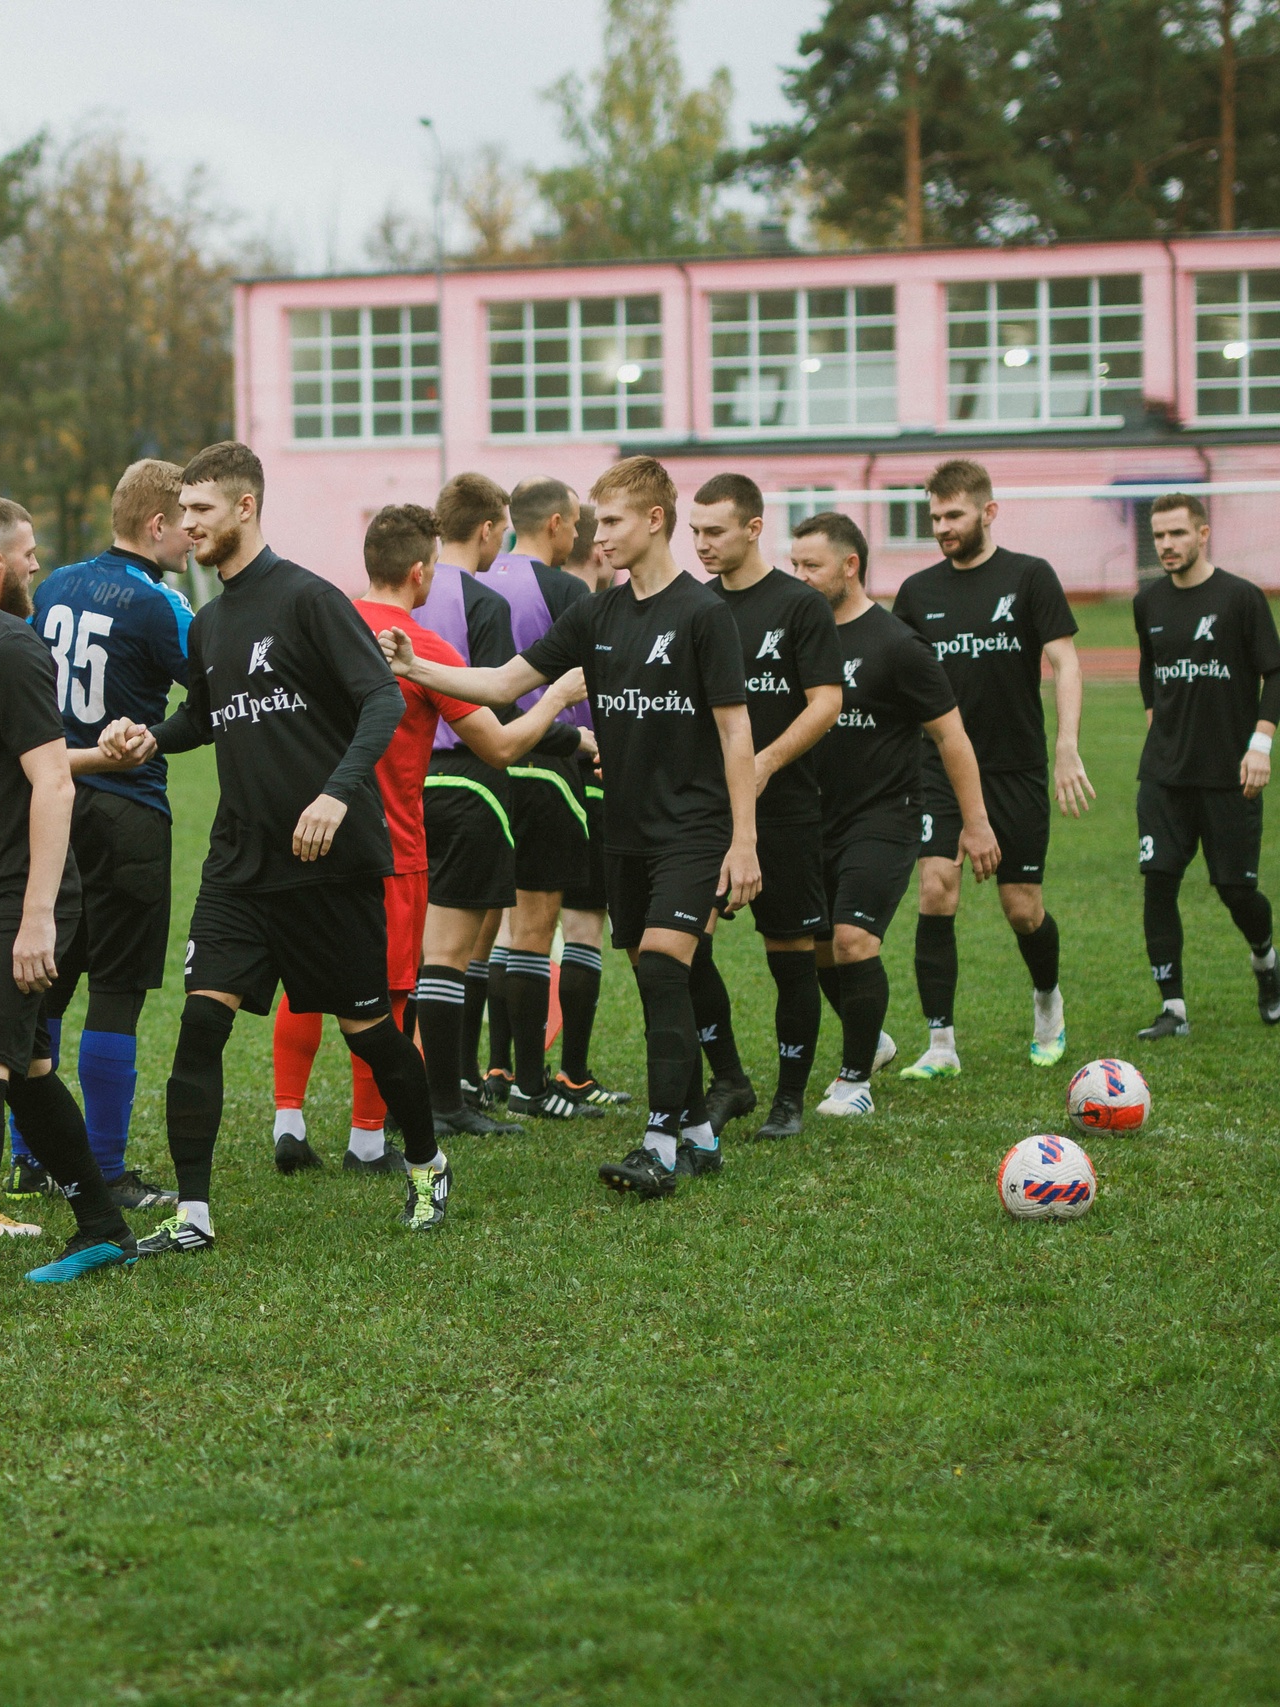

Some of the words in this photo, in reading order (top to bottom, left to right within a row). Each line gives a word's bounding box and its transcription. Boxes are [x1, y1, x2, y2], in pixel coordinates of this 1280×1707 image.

[43, 604, 114, 724] 35
[1154, 659, 1231, 685] гроТрейд
[210, 687, 308, 732] гроТрейд
[597, 688, 696, 719] гроТрейд
[1139, 835, 1154, 863] 3
